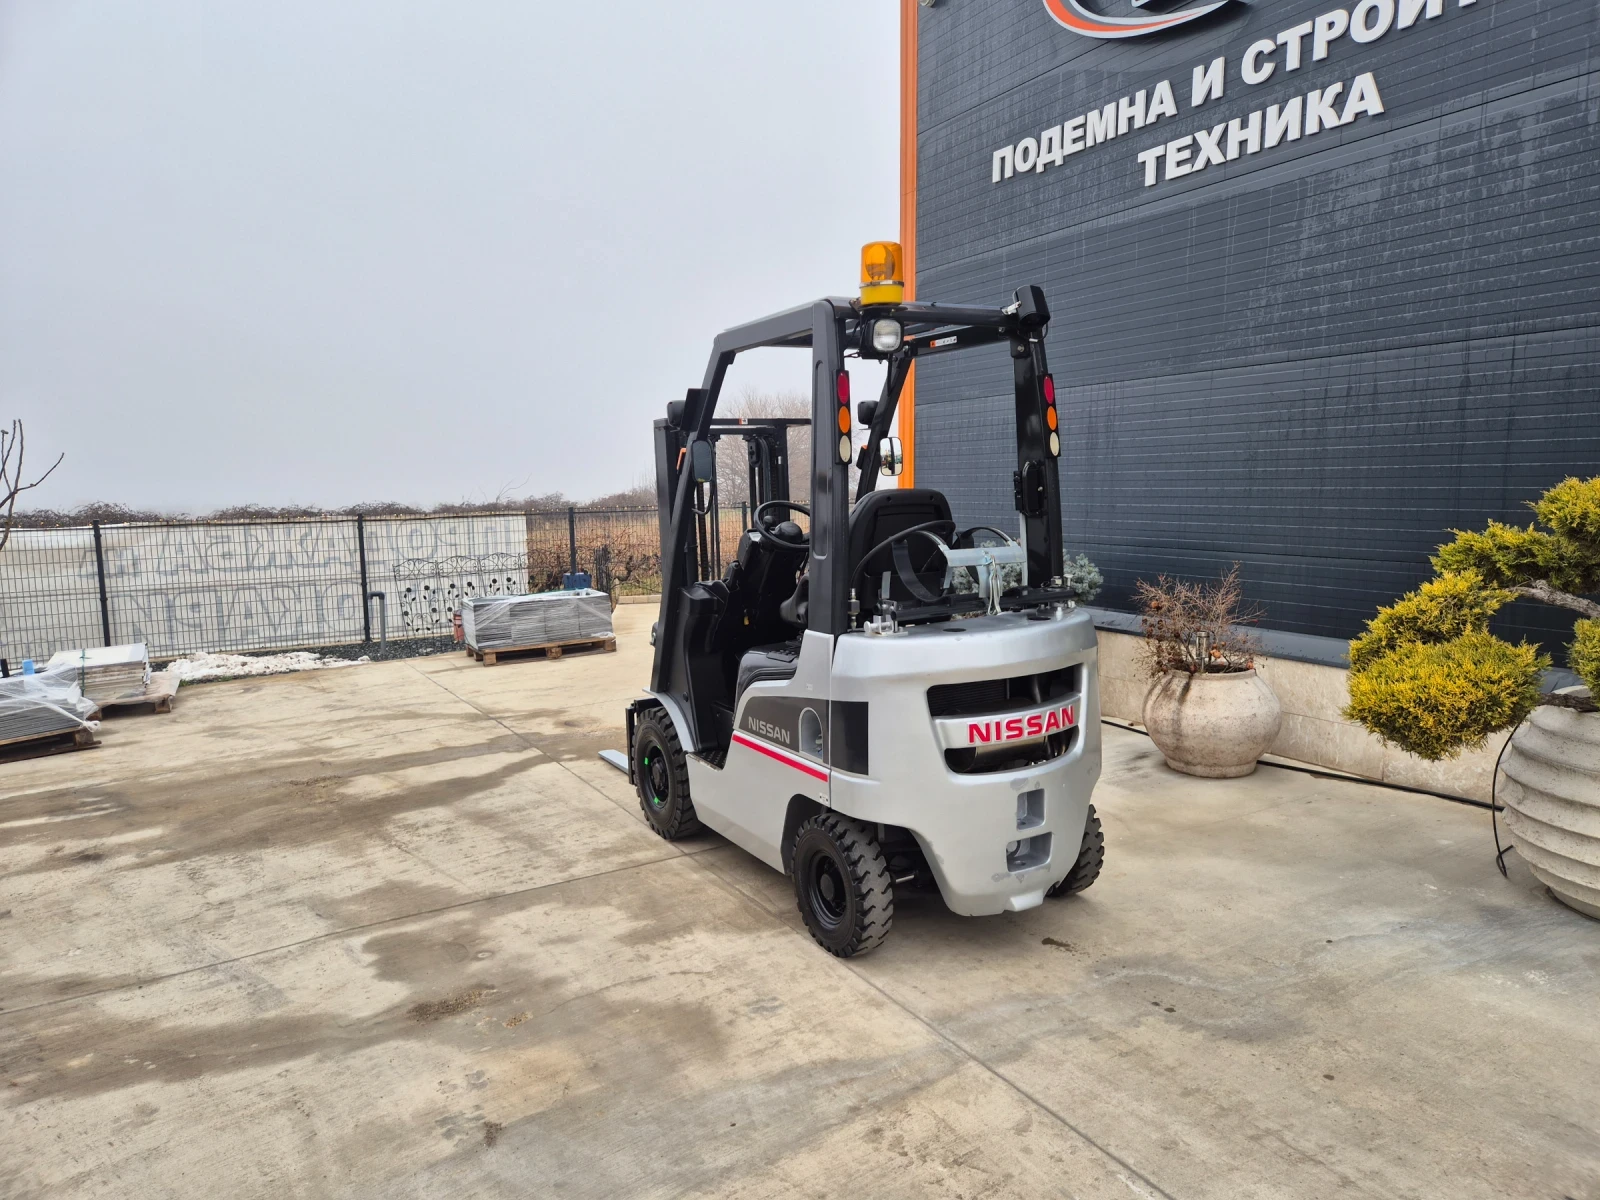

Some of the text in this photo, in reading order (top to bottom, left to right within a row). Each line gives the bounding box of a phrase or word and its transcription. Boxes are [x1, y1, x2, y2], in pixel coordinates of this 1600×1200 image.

[992, 0, 1477, 183] ПОДЕМНА И СТРОИ
[1137, 71, 1385, 187] ТЕХНИКА
[748, 716, 790, 744] NISSAN
[968, 705, 1075, 744] NISSAN
